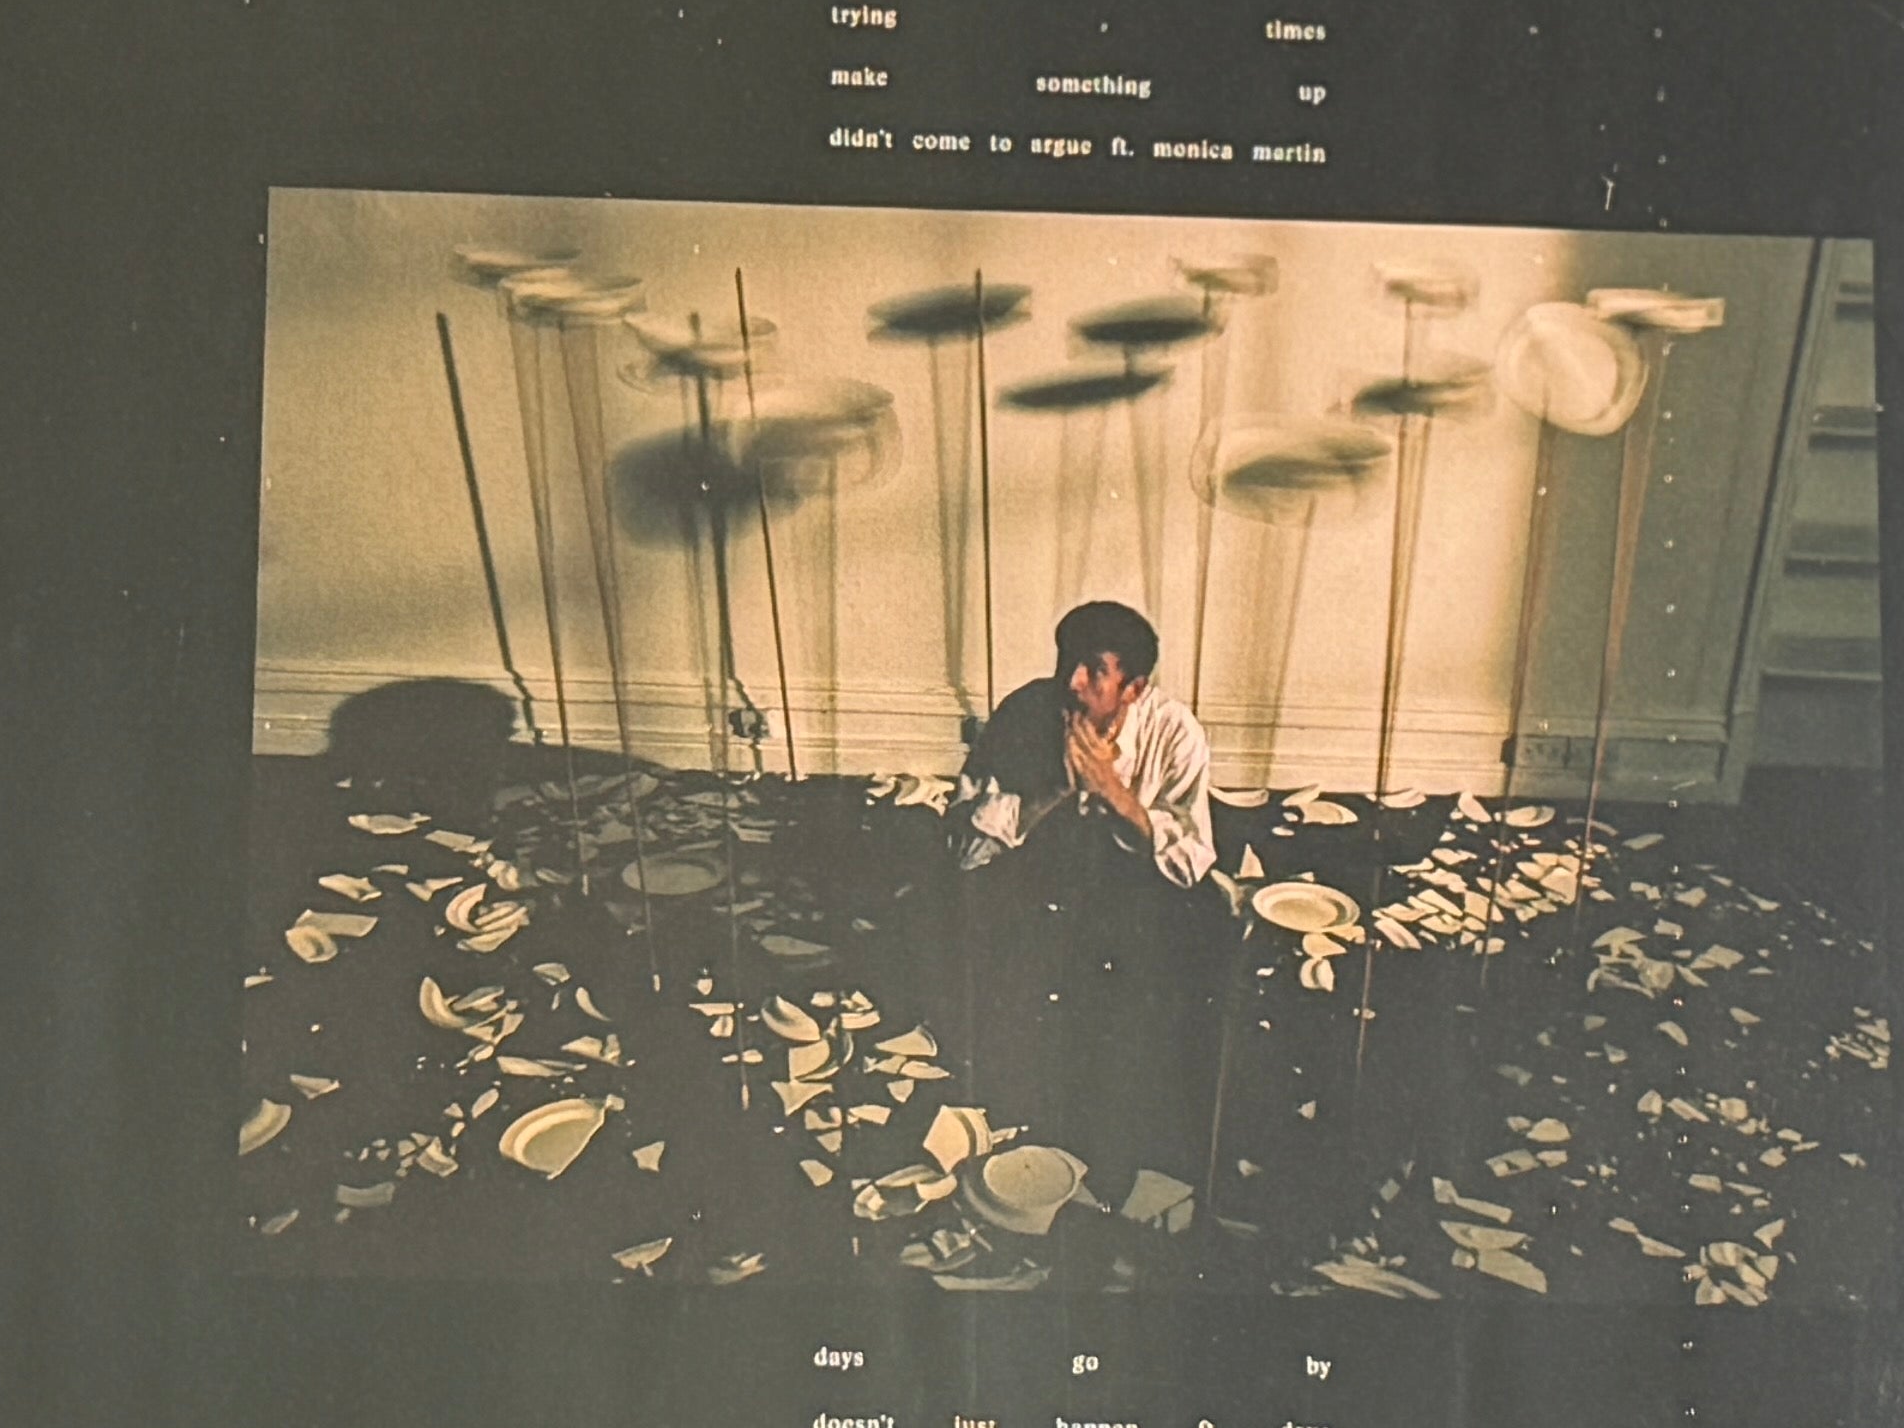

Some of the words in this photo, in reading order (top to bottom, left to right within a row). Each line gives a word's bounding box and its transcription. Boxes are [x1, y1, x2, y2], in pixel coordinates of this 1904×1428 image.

[831, 4, 897, 29] trying
[1265, 19, 1326, 41] times
[830, 66, 888, 87] make
[1036, 74, 1152, 99] something
[1298, 85, 1327, 106] up
[829, 127, 893, 149] didn't
[911, 134, 971, 151] come
[989, 134, 1013, 153] to
[1030, 138, 1092, 158] argue
[1153, 139, 1234, 161] monica
[1252, 142, 1326, 164] martin
[813, 1346, 864, 1371] days
[1072, 1354, 1099, 1375] go
[1306, 1355, 1332, 1380] by
